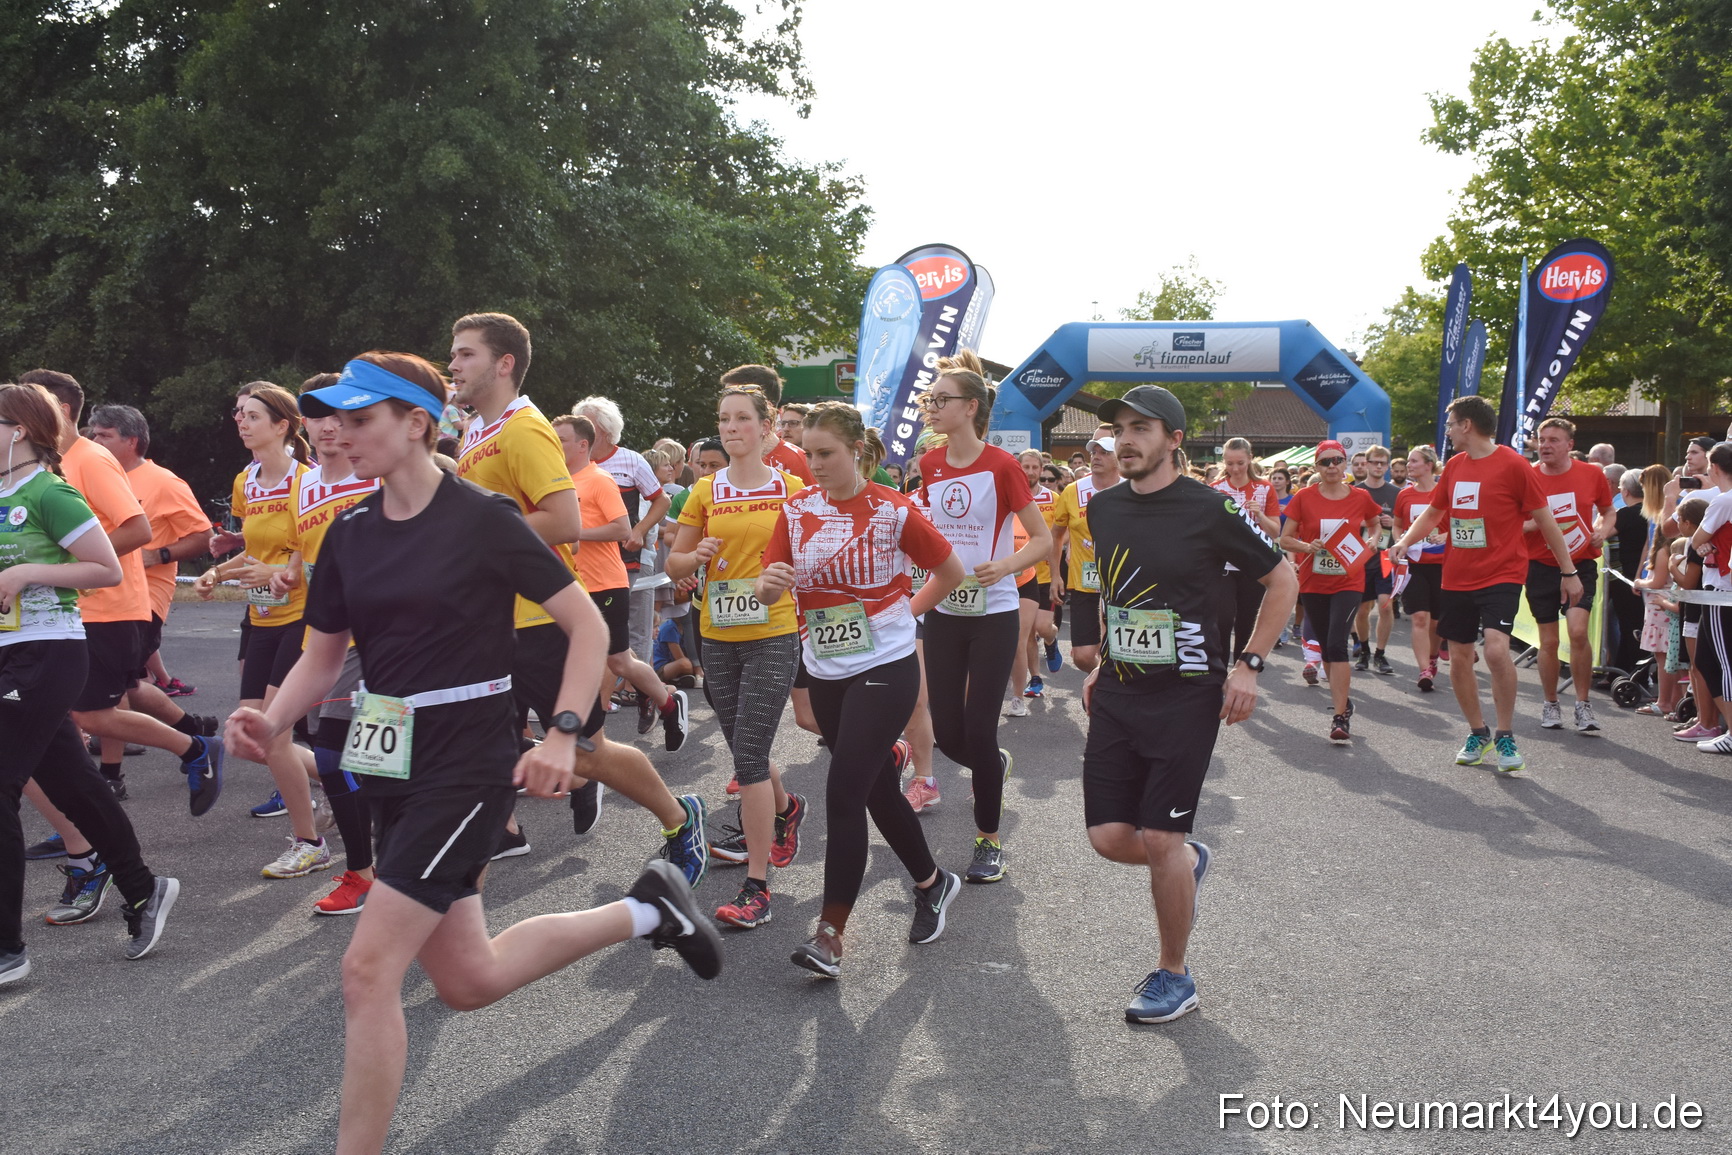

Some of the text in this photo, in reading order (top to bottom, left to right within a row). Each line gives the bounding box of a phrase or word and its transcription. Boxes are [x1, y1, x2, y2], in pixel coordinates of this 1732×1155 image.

[1544, 264, 1602, 291] Hervis
[967, 289, 985, 343] AUTOMOBILE
[1179, 337, 1203, 345] Fischer
[1160, 351, 1232, 365] firmenlauf
[891, 304, 959, 457] #GETMOVIN
[1026, 373, 1065, 384] Fischer
[472, 441, 501, 466] BÖGL
[711, 505, 743, 517] MAX
[297, 509, 329, 535] MAX
[1455, 529, 1475, 540] 537
[1319, 558, 1341, 568] 465
[715, 595, 760, 614] 1706
[948, 588, 979, 604] 897
[814, 621, 862, 645] 2225
[1114, 626, 1162, 649] 1741
